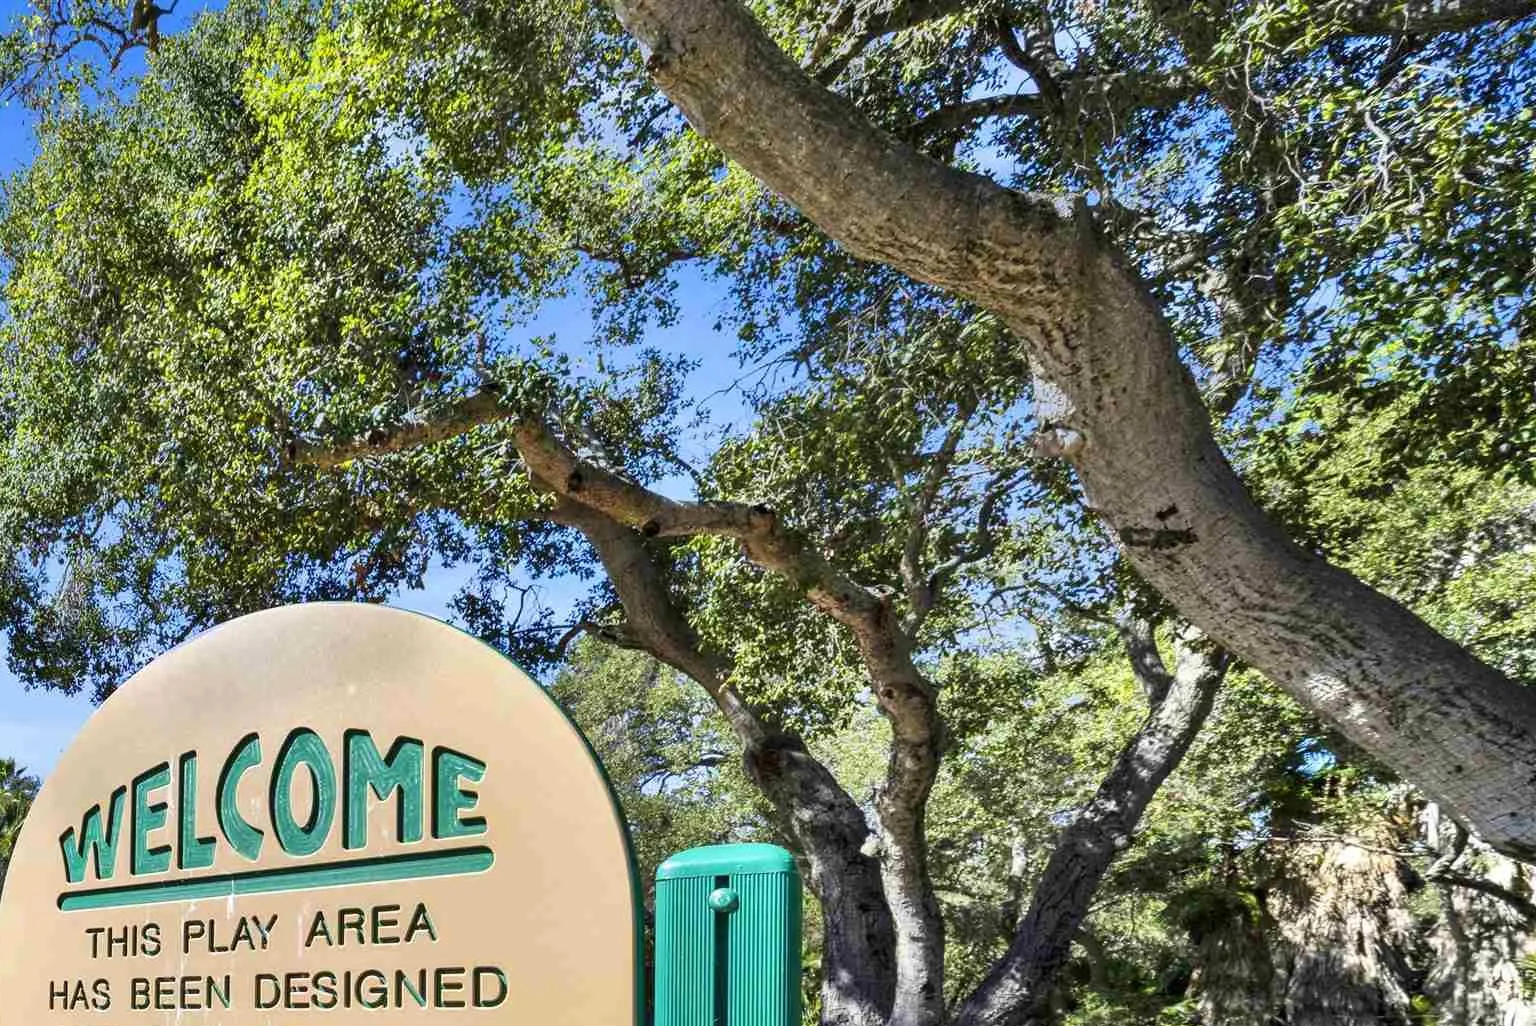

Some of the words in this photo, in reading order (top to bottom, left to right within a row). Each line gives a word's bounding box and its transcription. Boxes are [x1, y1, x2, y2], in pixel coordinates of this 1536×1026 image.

[59, 726, 489, 883] WELCOME
[84, 924, 161, 958] THIS
[183, 914, 278, 954] PLAY
[305, 903, 436, 948] AREA
[49, 979, 111, 1010] HAS
[130, 975, 231, 1010] BEEN
[254, 965, 508, 1009] DESIGNED
